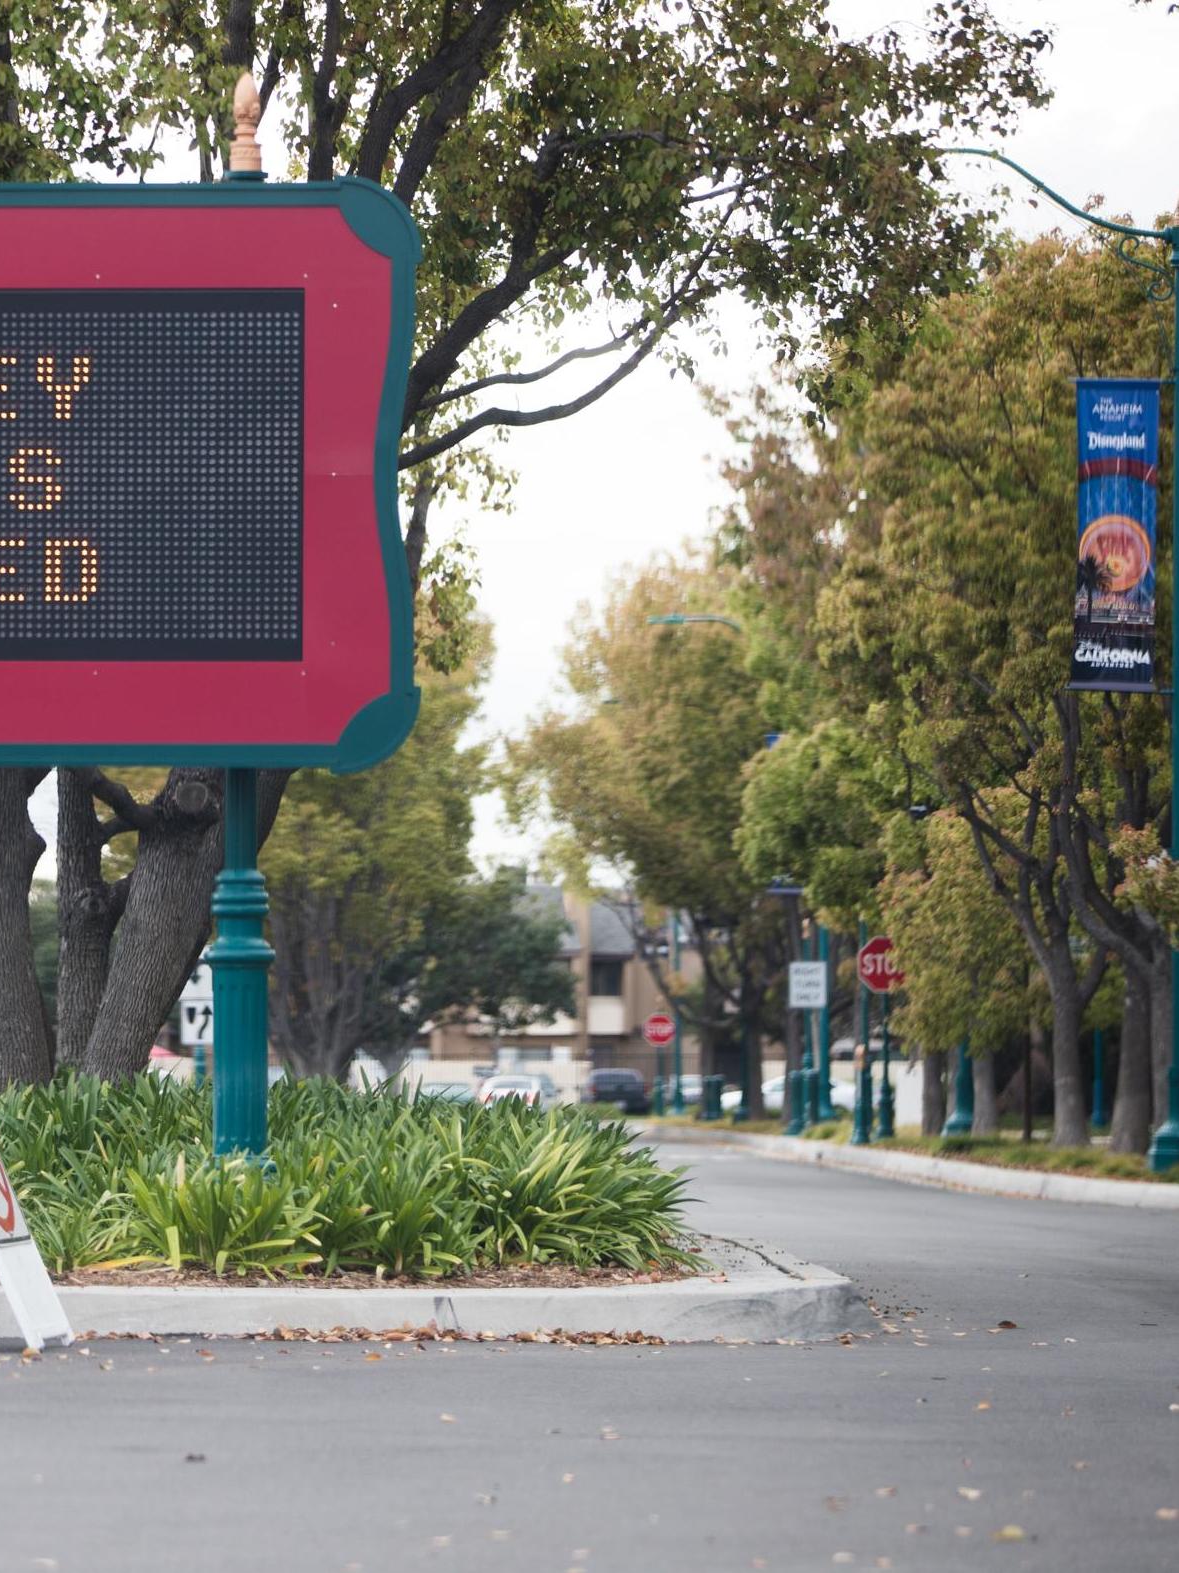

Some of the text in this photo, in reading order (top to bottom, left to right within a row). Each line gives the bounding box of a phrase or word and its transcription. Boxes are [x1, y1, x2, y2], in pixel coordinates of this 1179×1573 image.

[1092, 403, 1143, 415] ANAHEIM
[1087, 431, 1146, 451] Disneyland
[1074, 647, 1151, 665] CALIFORNIA
[861, 953, 900, 975] STO
[644, 1022, 675, 1037] STOP
